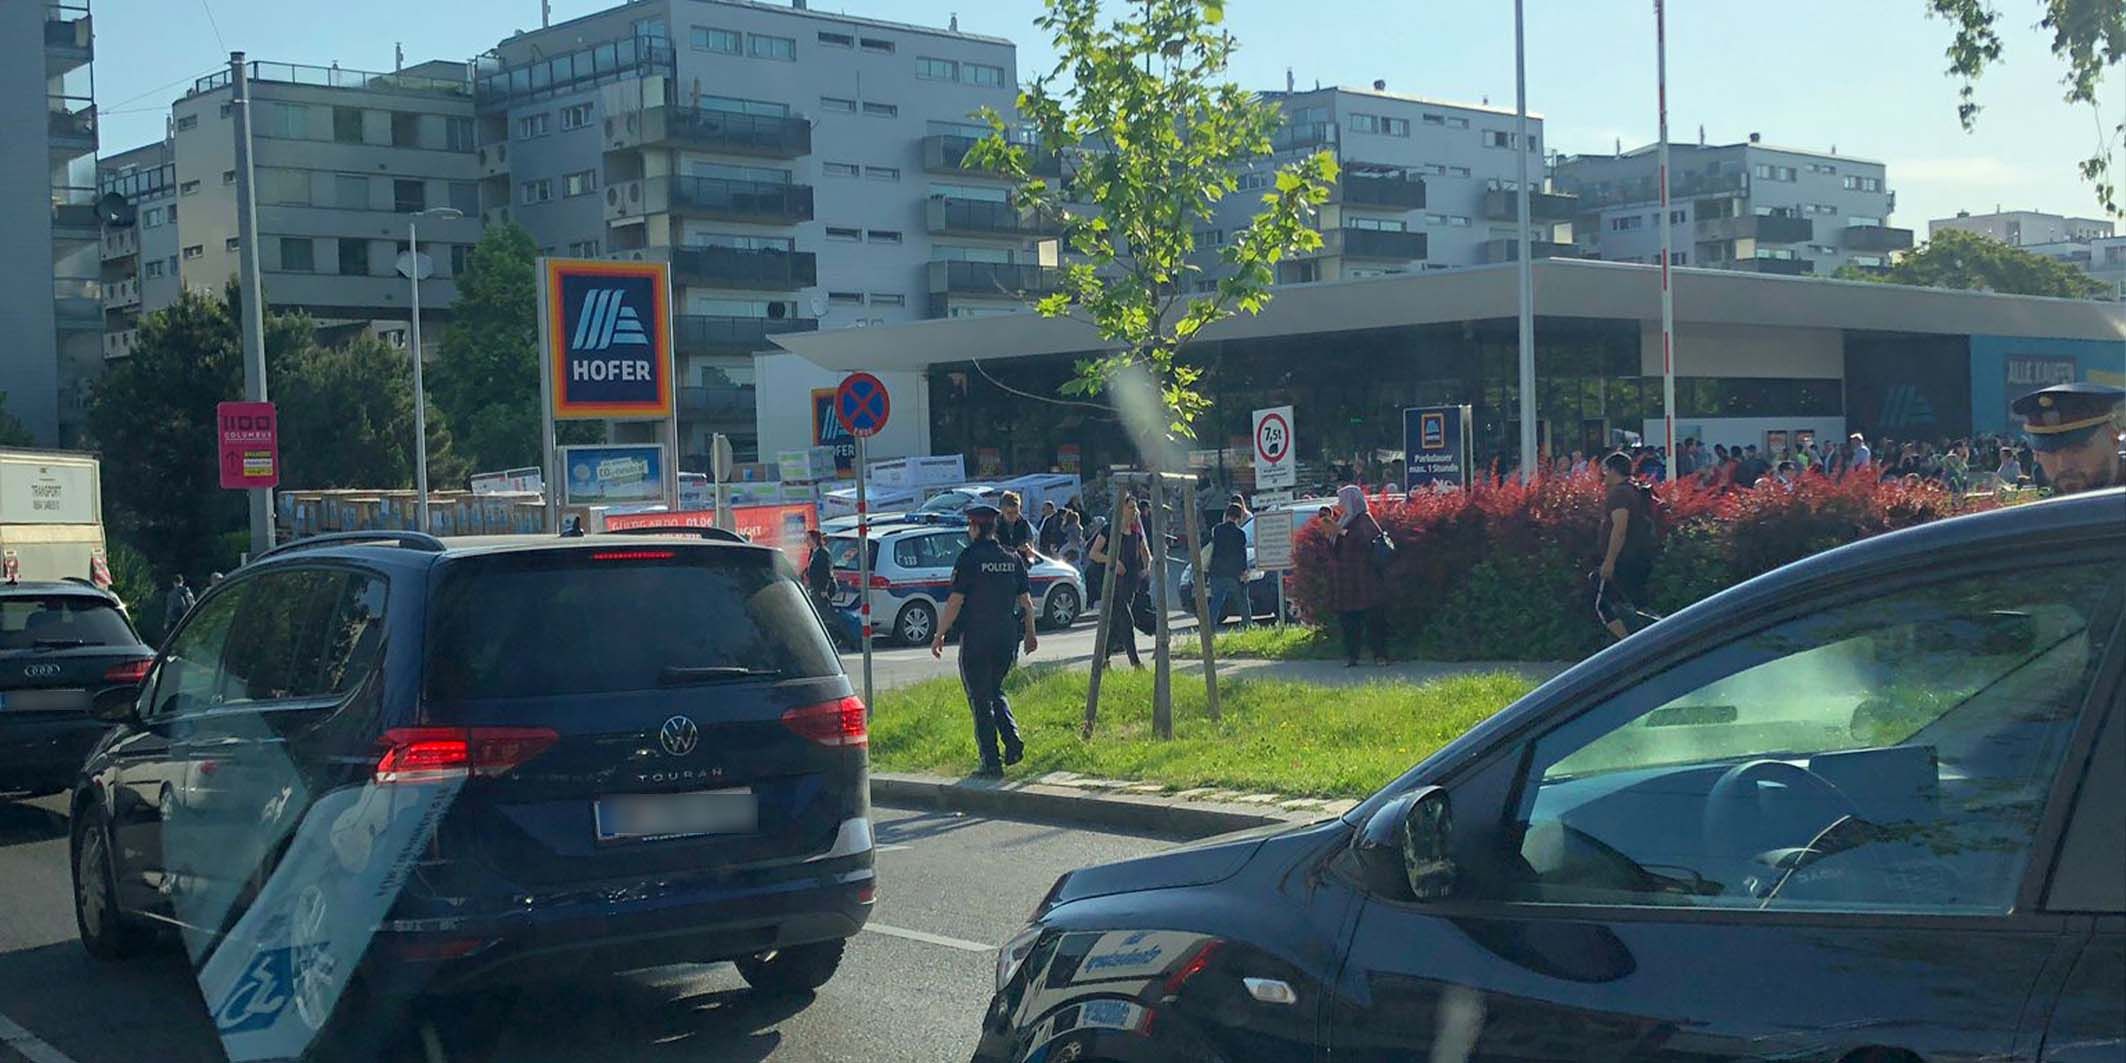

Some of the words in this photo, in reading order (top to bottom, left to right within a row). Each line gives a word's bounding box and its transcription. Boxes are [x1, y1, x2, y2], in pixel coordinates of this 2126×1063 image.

[573, 360, 651, 381] HOFER
[223, 431, 271, 439] COLUMBUS
[1264, 427, 1282, 443] 7,5t
[1414, 454, 1453, 463] Parkdauer
[1432, 464, 1459, 473] Stunde
[981, 562, 1016, 573] POLIZEI
[638, 768, 723, 783] TOURAN
